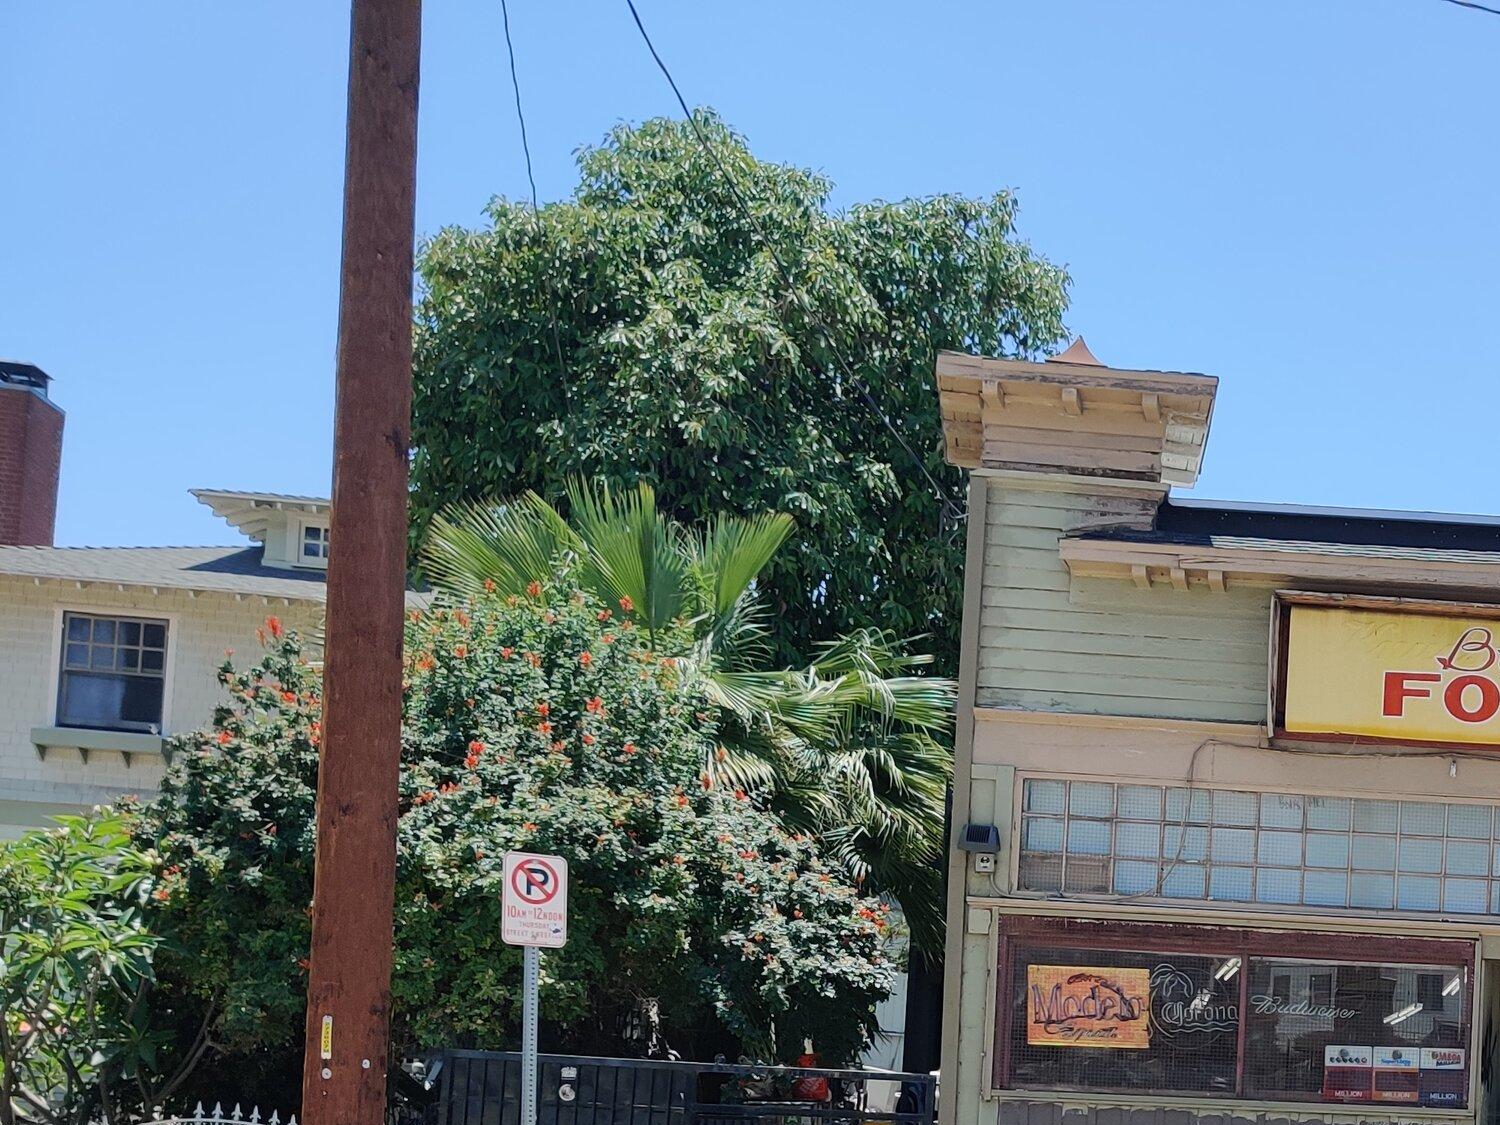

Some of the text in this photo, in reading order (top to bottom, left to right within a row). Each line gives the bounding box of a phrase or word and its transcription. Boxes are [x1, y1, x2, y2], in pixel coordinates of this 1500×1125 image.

[520, 921, 550, 929] THURSDAY
[1031, 983, 1144, 1024] Modelo
[1250, 995, 1361, 1018] Budweiser
[1161, 1000, 1239, 1026] Corona
[1335, 1090, 1363, 1098] MILLION
[1382, 1091, 1410, 1099] MILLION
